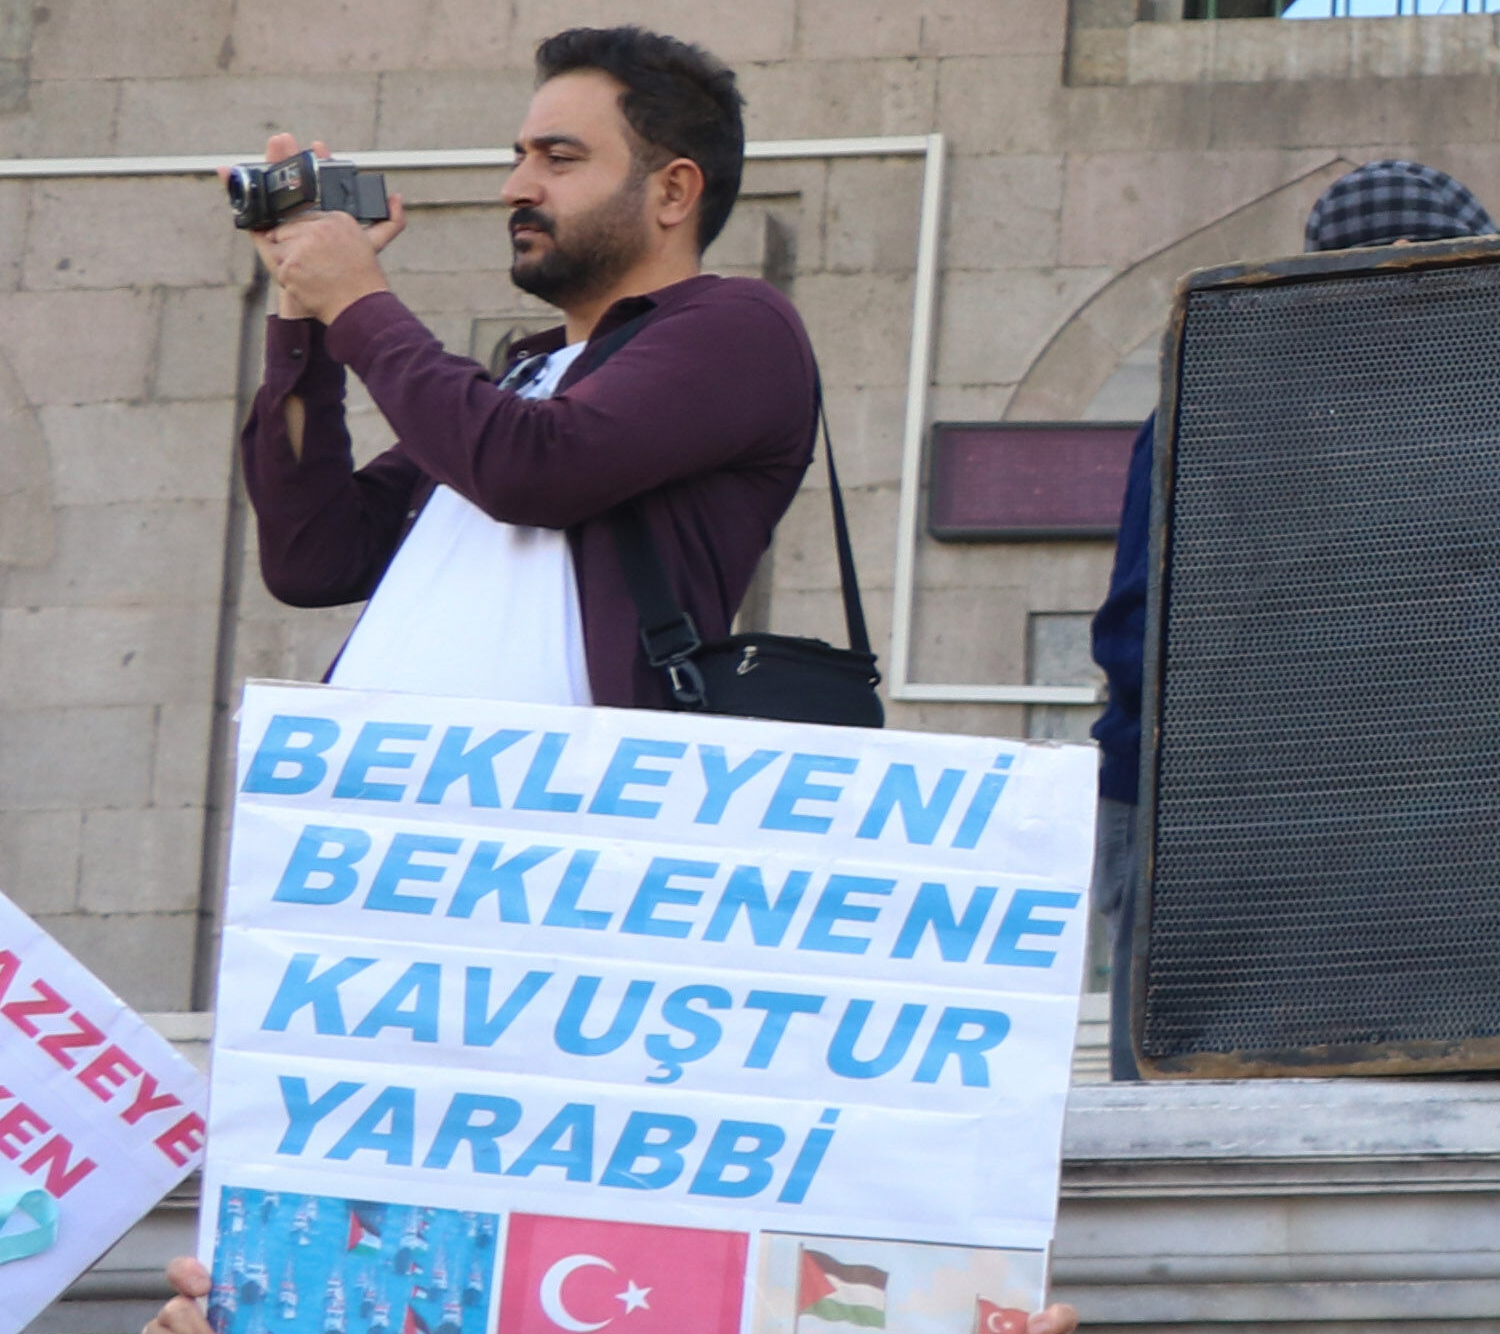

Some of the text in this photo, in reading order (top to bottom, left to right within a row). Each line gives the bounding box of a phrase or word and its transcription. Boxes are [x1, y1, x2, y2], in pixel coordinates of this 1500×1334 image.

[241, 715, 1015, 849] BEKLEYENİ
[272, 825, 1082, 968] BEKLENENE
[261, 953, 1012, 1085] KAVUŞTUR
[0, 1084, 98, 1199] EN
[277, 1075, 837, 1205] YARABBİ
